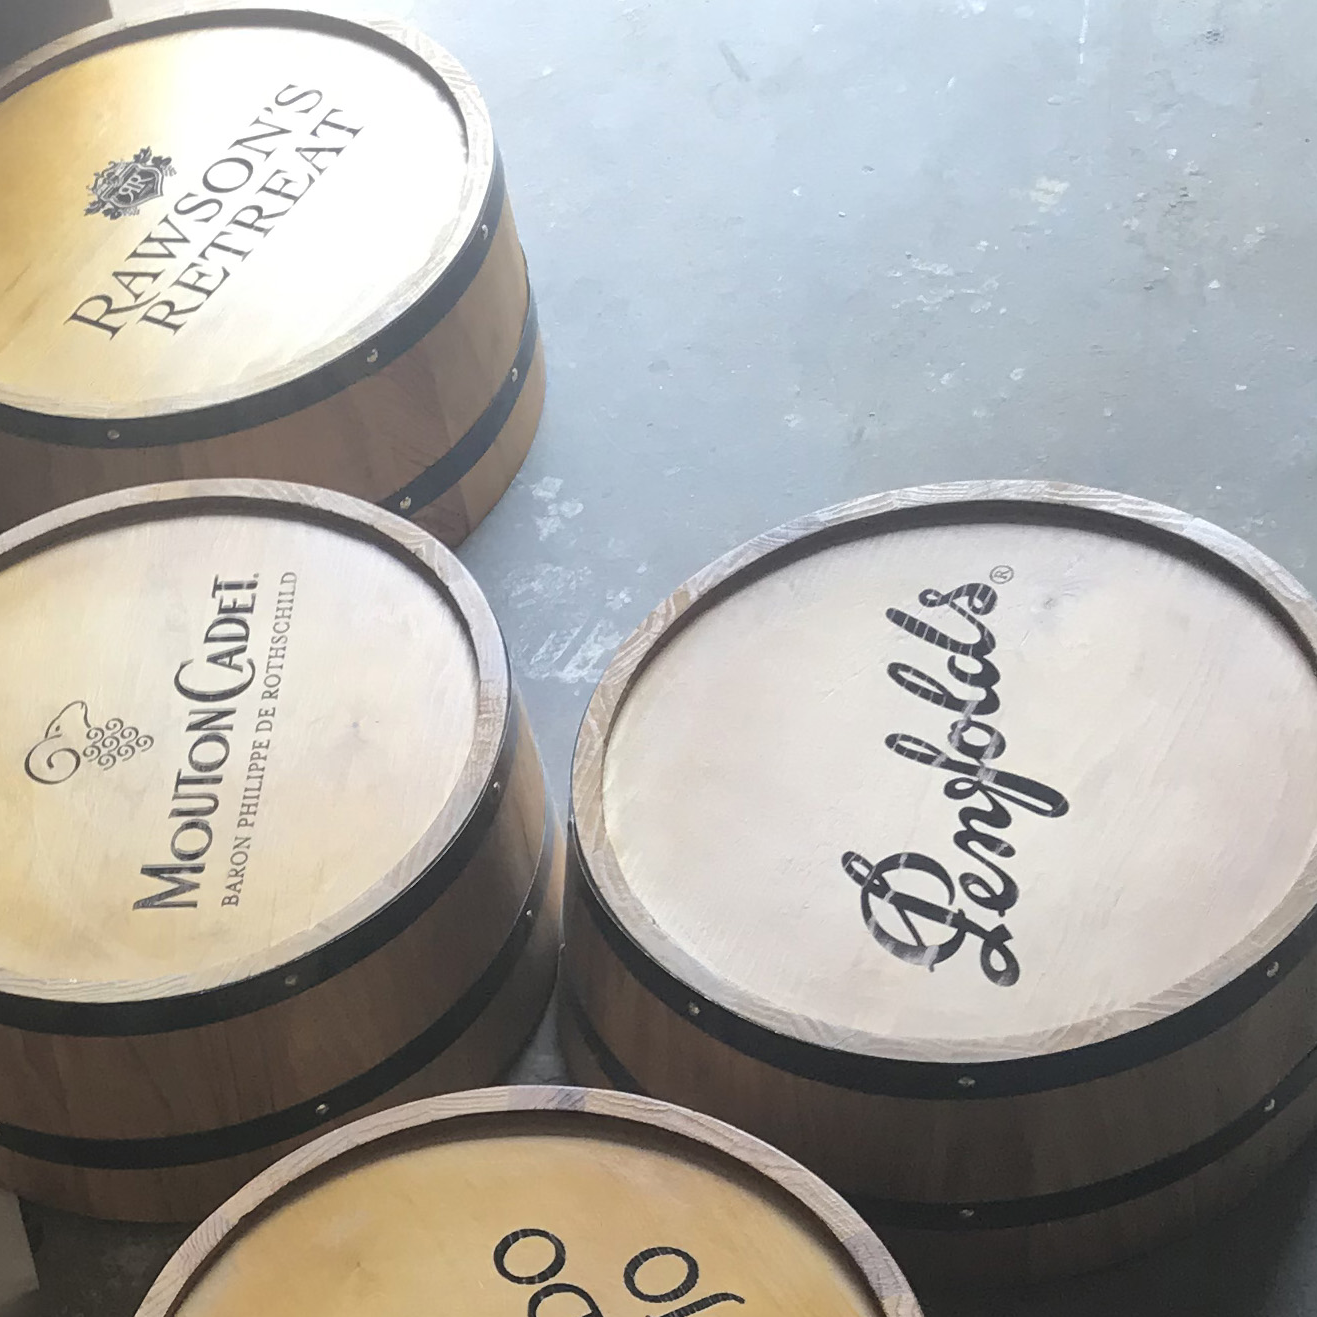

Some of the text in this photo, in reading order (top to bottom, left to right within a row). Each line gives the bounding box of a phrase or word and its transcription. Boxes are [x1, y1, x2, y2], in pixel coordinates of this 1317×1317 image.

[63, 83, 324, 340] RAWSON'S
[136, 107, 364, 336] RETREAT
[133, 706, 238, 912] MOUTON
[221, 570, 299, 908] BARON PHILIPPE DE ROTHSCHILD
